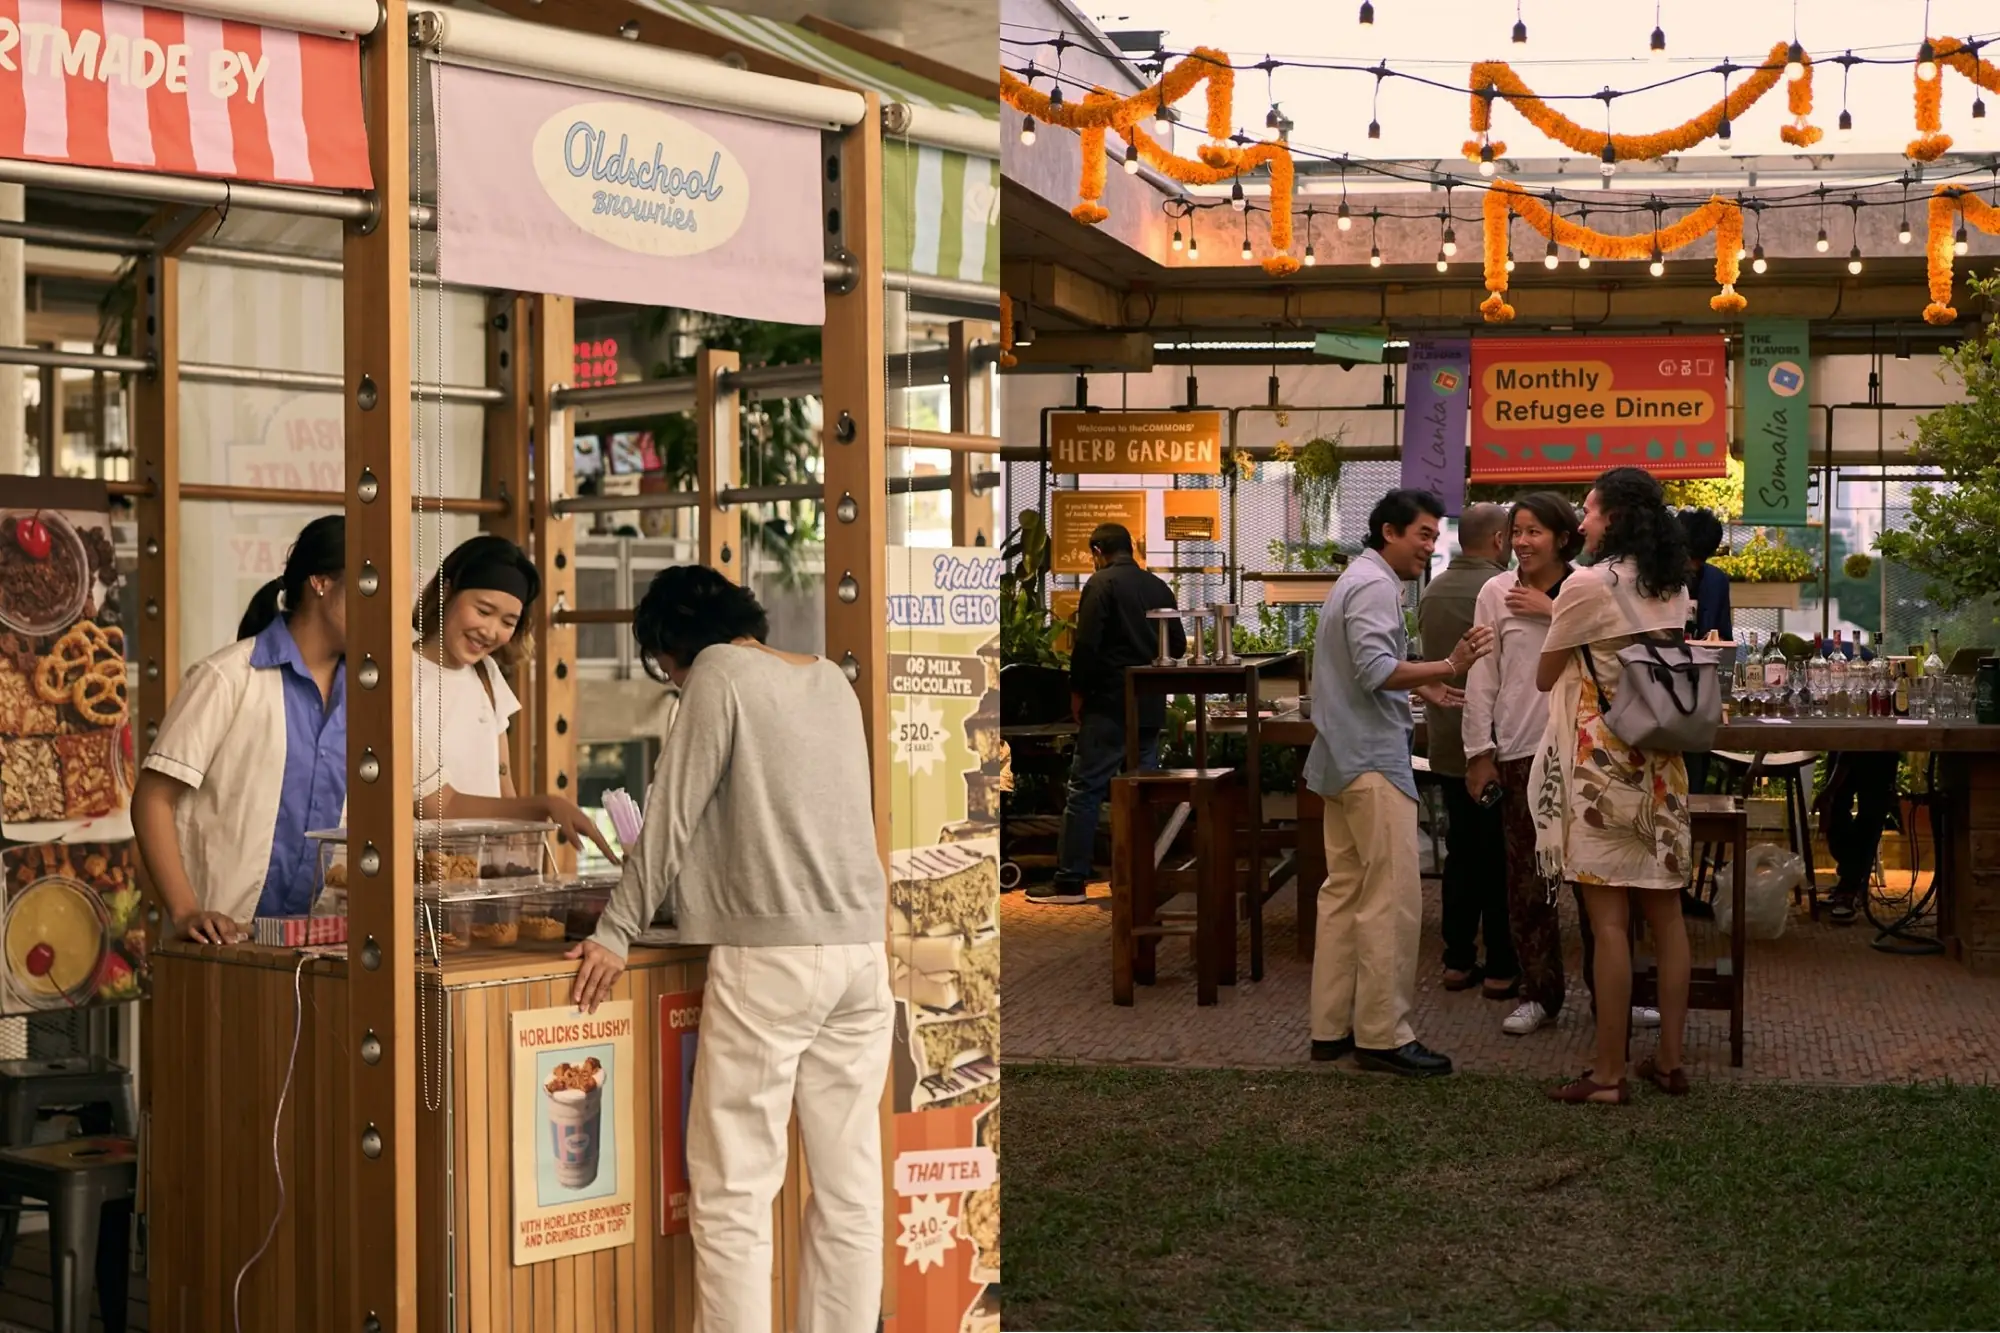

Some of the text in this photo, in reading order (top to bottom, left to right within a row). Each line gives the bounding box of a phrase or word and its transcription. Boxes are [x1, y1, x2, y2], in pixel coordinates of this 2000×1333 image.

[208, 50, 269, 104] BY
[564, 121, 723, 202] Oldschool
[592, 190, 697, 232] Brownies
[1750, 335, 1771, 344] THE
[1750, 346, 1800, 355] FLAVORS
[1749, 357, 1768, 367] OF:
[1496, 368, 1599, 391] Monthly
[1496, 397, 1704, 424] Refugee Dinner
[1077, 424, 1116, 432] Welcome
[1118, 424, 1127, 432] to
[1421, 400, 1448, 470] Lanka
[1059, 438, 1213, 463] HERB GARDEN
[1759, 407, 1789, 509] Somalia
[927, 659, 961, 676] MILK
[893, 675, 972, 695] CHOCOLATE
[520, 1019, 630, 1047] HORLICKS SLUSHY!
[908, 1161, 981, 1183] THAI TEA
[520, 1203, 631, 1234] WITH HORLICKS BROWNIES
[525, 1218, 626, 1248] AND CRUMBLES ON TOP!
